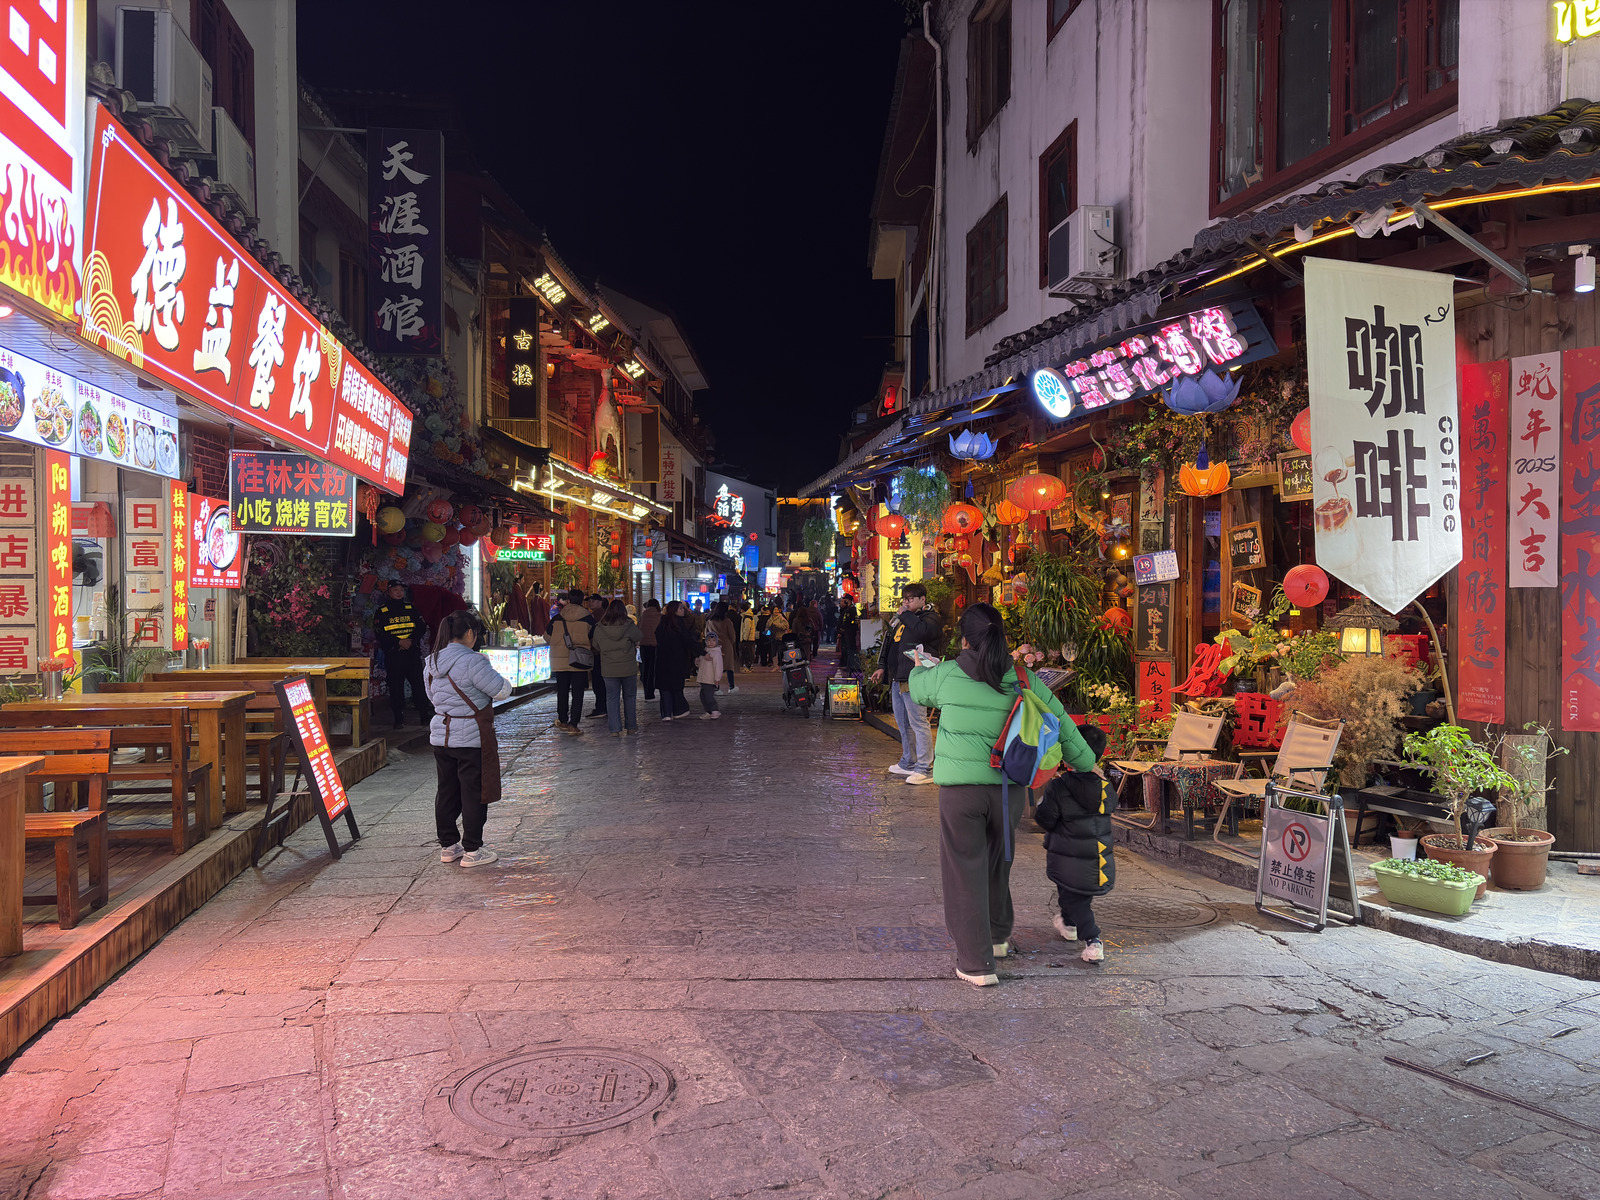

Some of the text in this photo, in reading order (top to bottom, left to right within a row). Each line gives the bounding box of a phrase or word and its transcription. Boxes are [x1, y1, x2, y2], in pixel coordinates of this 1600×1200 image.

[380, 140, 431, 342] 天涯酒馆
[131, 196, 321, 431] 德益餐饮
[78, 382, 101, 402] 桂林米粉
[1345, 304, 1431, 541] 咖啡
[237, 459, 347, 497] 桂林米粉
[663, 450, 675, 499] 土特产批发
[1438, 415, 1458, 533] coffee
[1514, 362, 1557, 572] 蛇年 2025 大吉
[237, 497, 347, 529] 小吃 烧烤 宵夜
[499, 550, 543, 559] COCONUT
[1464, 398, 1501, 672] 萬事皆勝意
[0, 484, 29, 669] 进店暴富
[52, 463, 69, 657] 阳朔啤酒鱼
[172, 488, 187, 642] 桂林米粉 螺蛳粉
[1140, 560, 1151, 570] 18
[1569, 690, 1578, 720] LUCK
[1269, 877, 1315, 899] NO PARKING
[1271, 859, 1316, 885] 禁止停车
